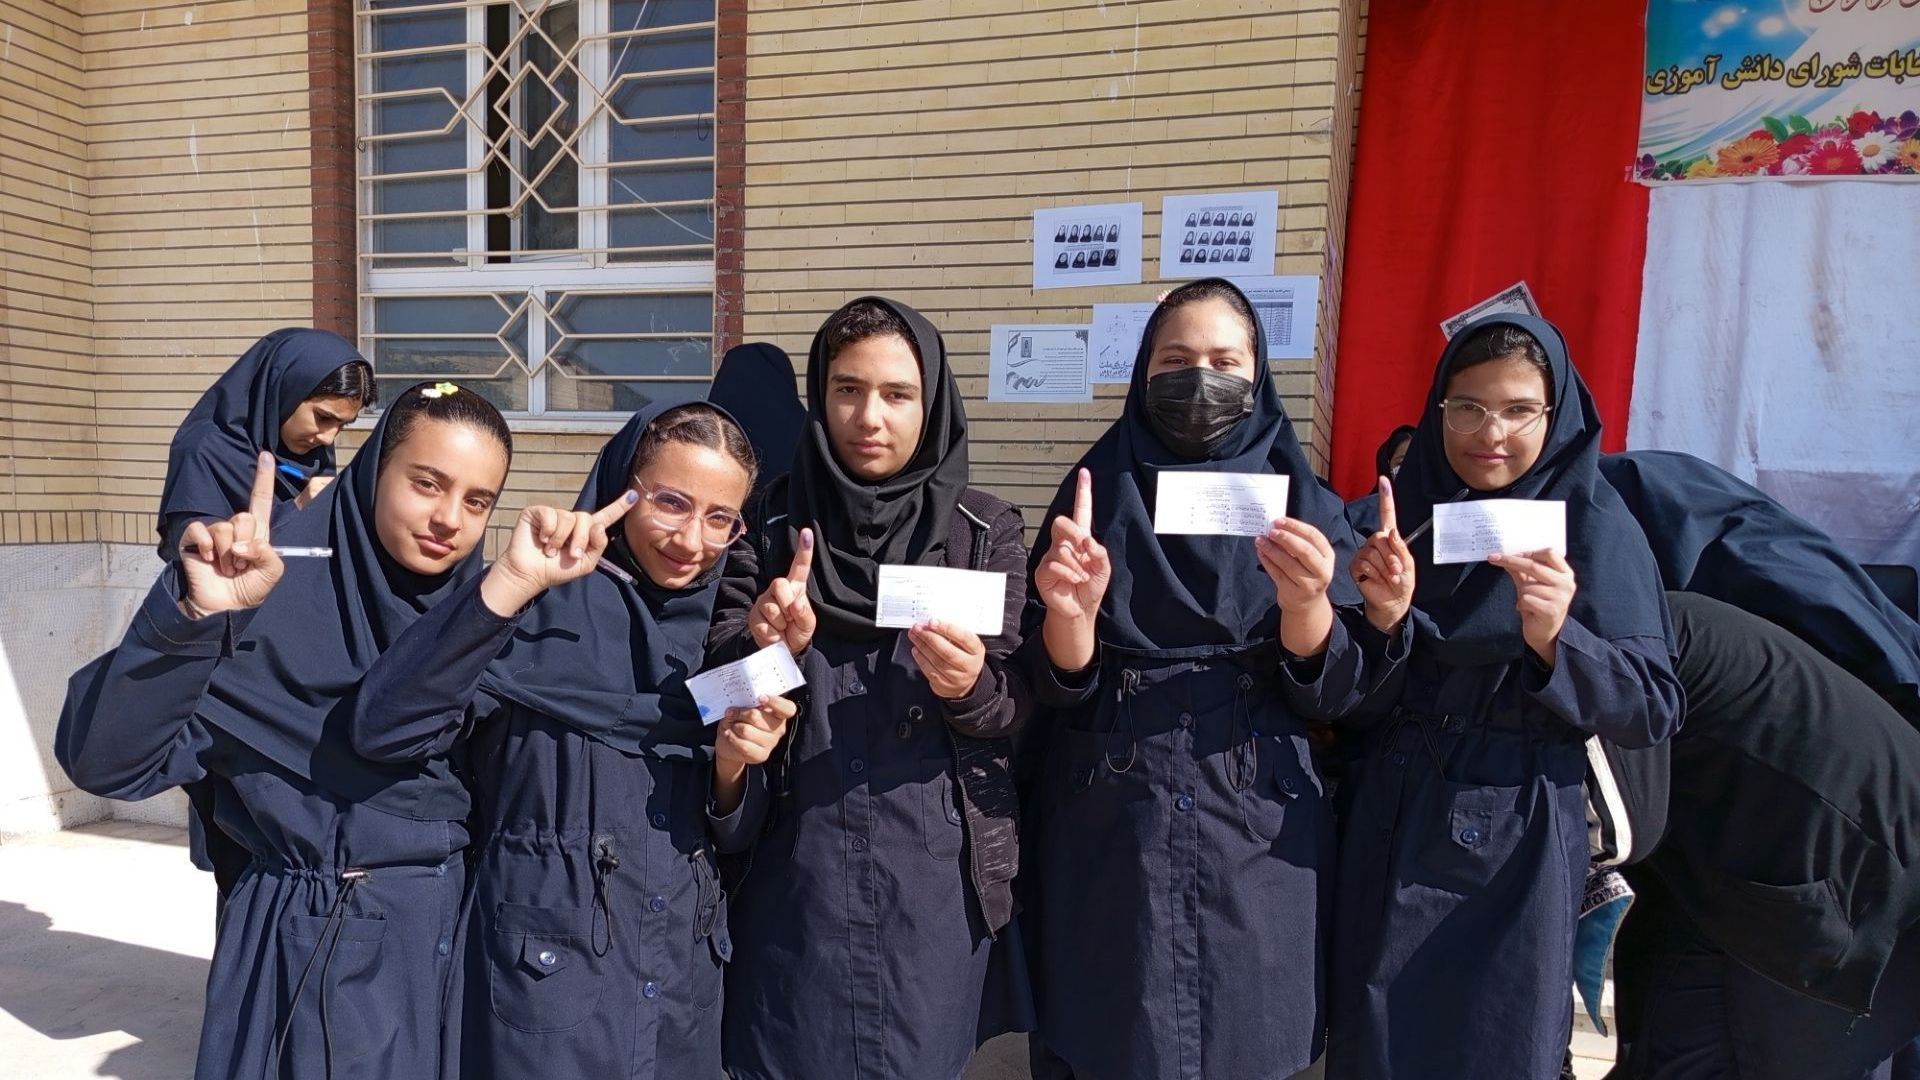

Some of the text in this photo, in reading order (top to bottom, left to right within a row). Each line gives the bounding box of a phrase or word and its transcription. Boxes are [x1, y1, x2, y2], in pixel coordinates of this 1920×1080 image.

[1645, 54, 1723, 94] آموزی
[1721, 53, 1785, 90] دانش
[1786, 51, 1862, 88] شورای
